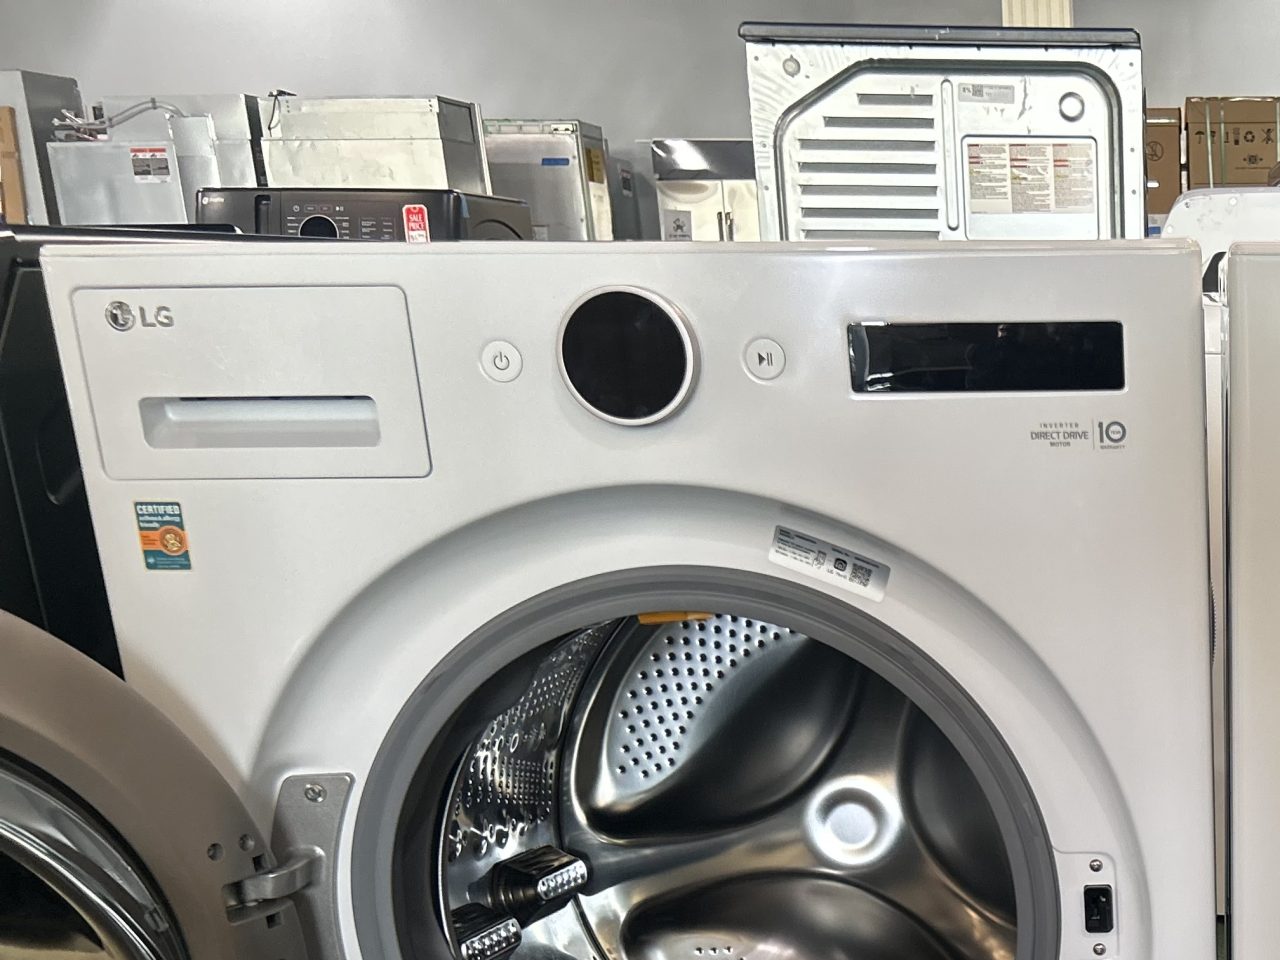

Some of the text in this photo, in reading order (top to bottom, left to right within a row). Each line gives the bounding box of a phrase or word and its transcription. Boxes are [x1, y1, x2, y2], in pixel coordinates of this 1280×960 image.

[409, 214, 423, 222] SALE
[409, 222, 425, 230] PRICE
[138, 305, 174, 328] LG
[1030, 431, 1089, 440] DIRECT DRIVE
[1098, 421, 1127, 443] 10
[136, 505, 180, 515] CERTIFIED
